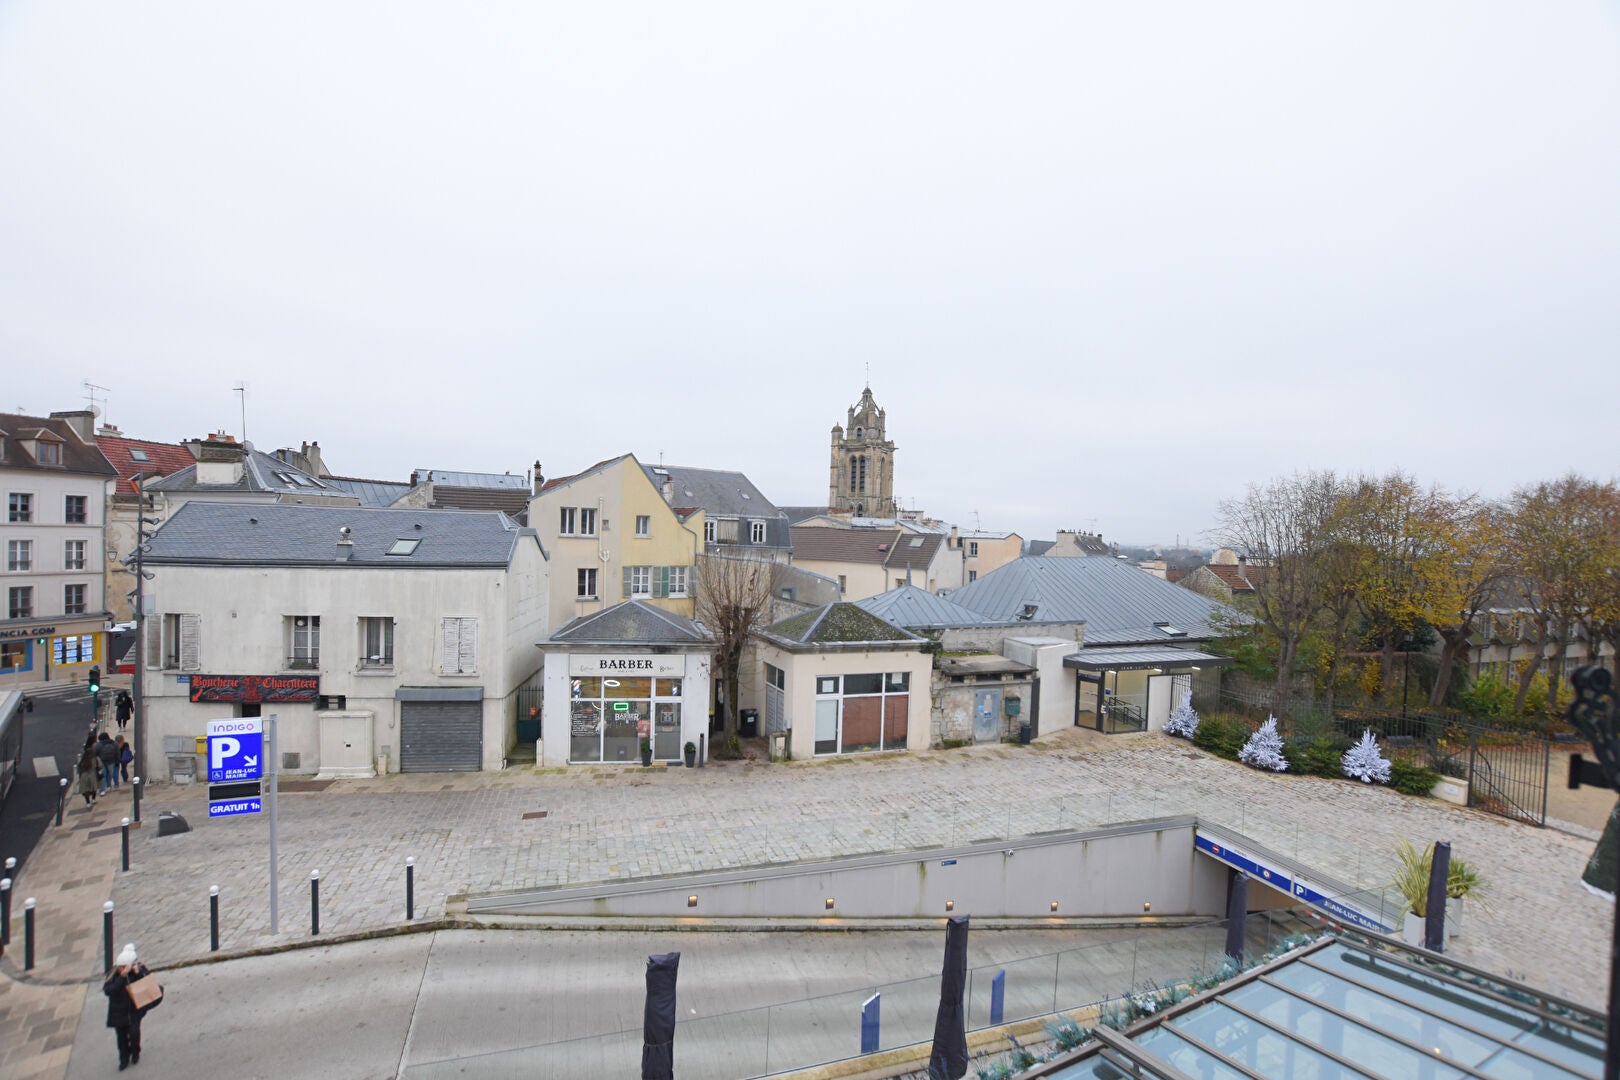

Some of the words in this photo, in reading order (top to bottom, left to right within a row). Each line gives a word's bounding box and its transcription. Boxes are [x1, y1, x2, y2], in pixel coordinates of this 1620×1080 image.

[599, 659, 653, 669] BARBER
[191, 675, 240, 687] Boucherie
[262, 677, 318, 688] Charcuterie
[213, 723, 255, 733] INDIGO
[211, 737, 240, 769] P
[225, 767, 257, 775] JEAN-LUC
[225, 772, 248, 780] MAIRE
[210, 803, 248, 813] GRATUIT
[250, 802, 261, 810] 1h
[1296, 885, 1305, 896] P
